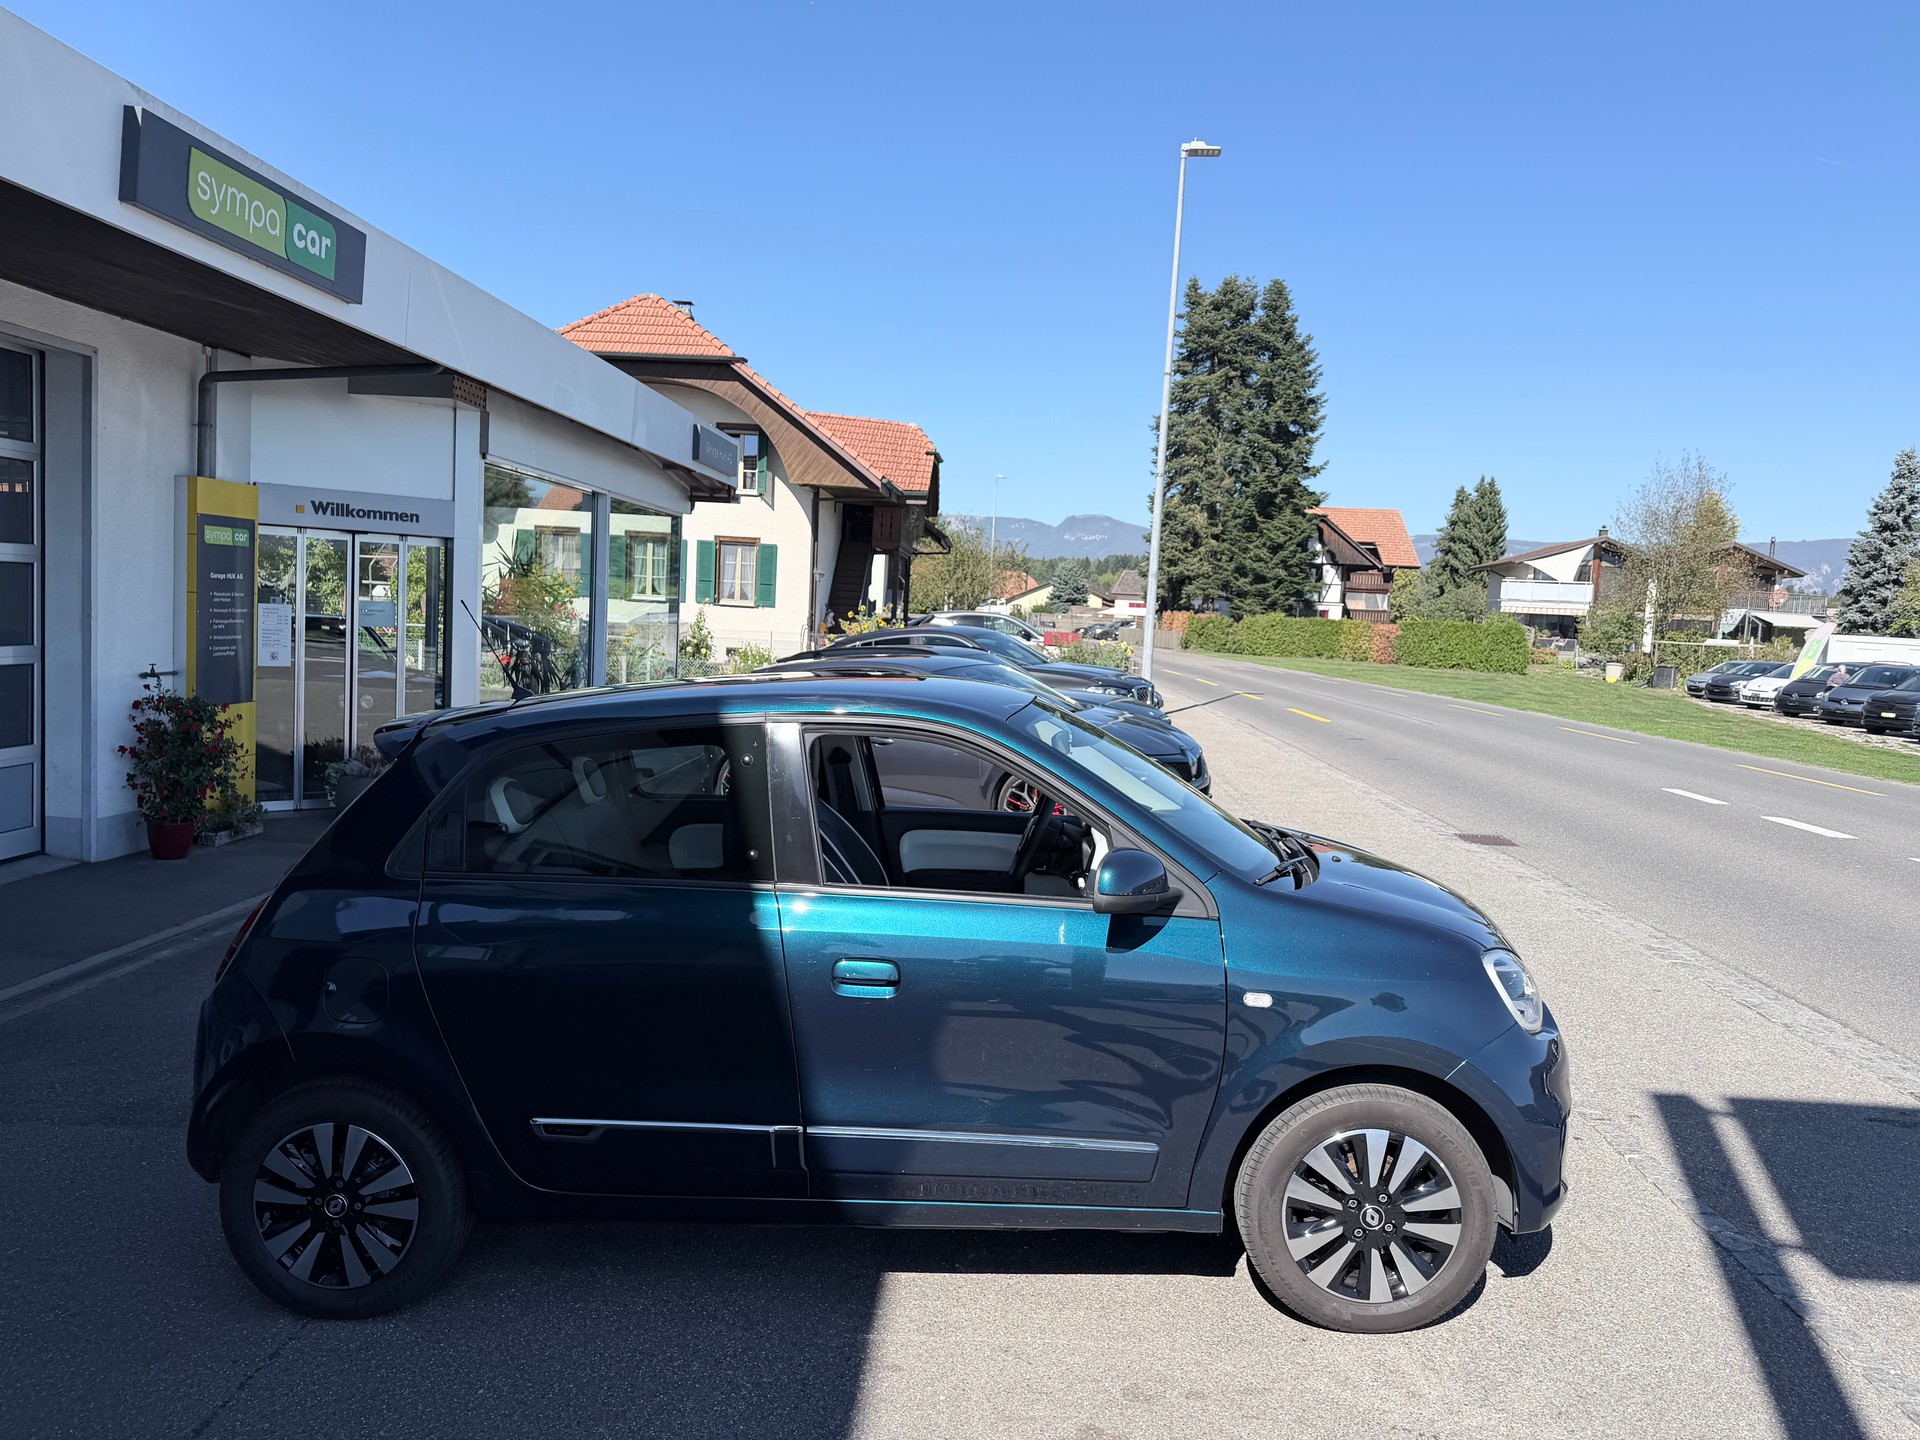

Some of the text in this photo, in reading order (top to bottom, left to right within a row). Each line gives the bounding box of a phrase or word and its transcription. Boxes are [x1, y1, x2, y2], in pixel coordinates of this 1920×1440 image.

[197, 171, 331, 260] sympa car
[310, 500, 420, 523] Willkommen
[206, 530, 247, 542] sympa car
[210, 572, 226, 580] Garage
